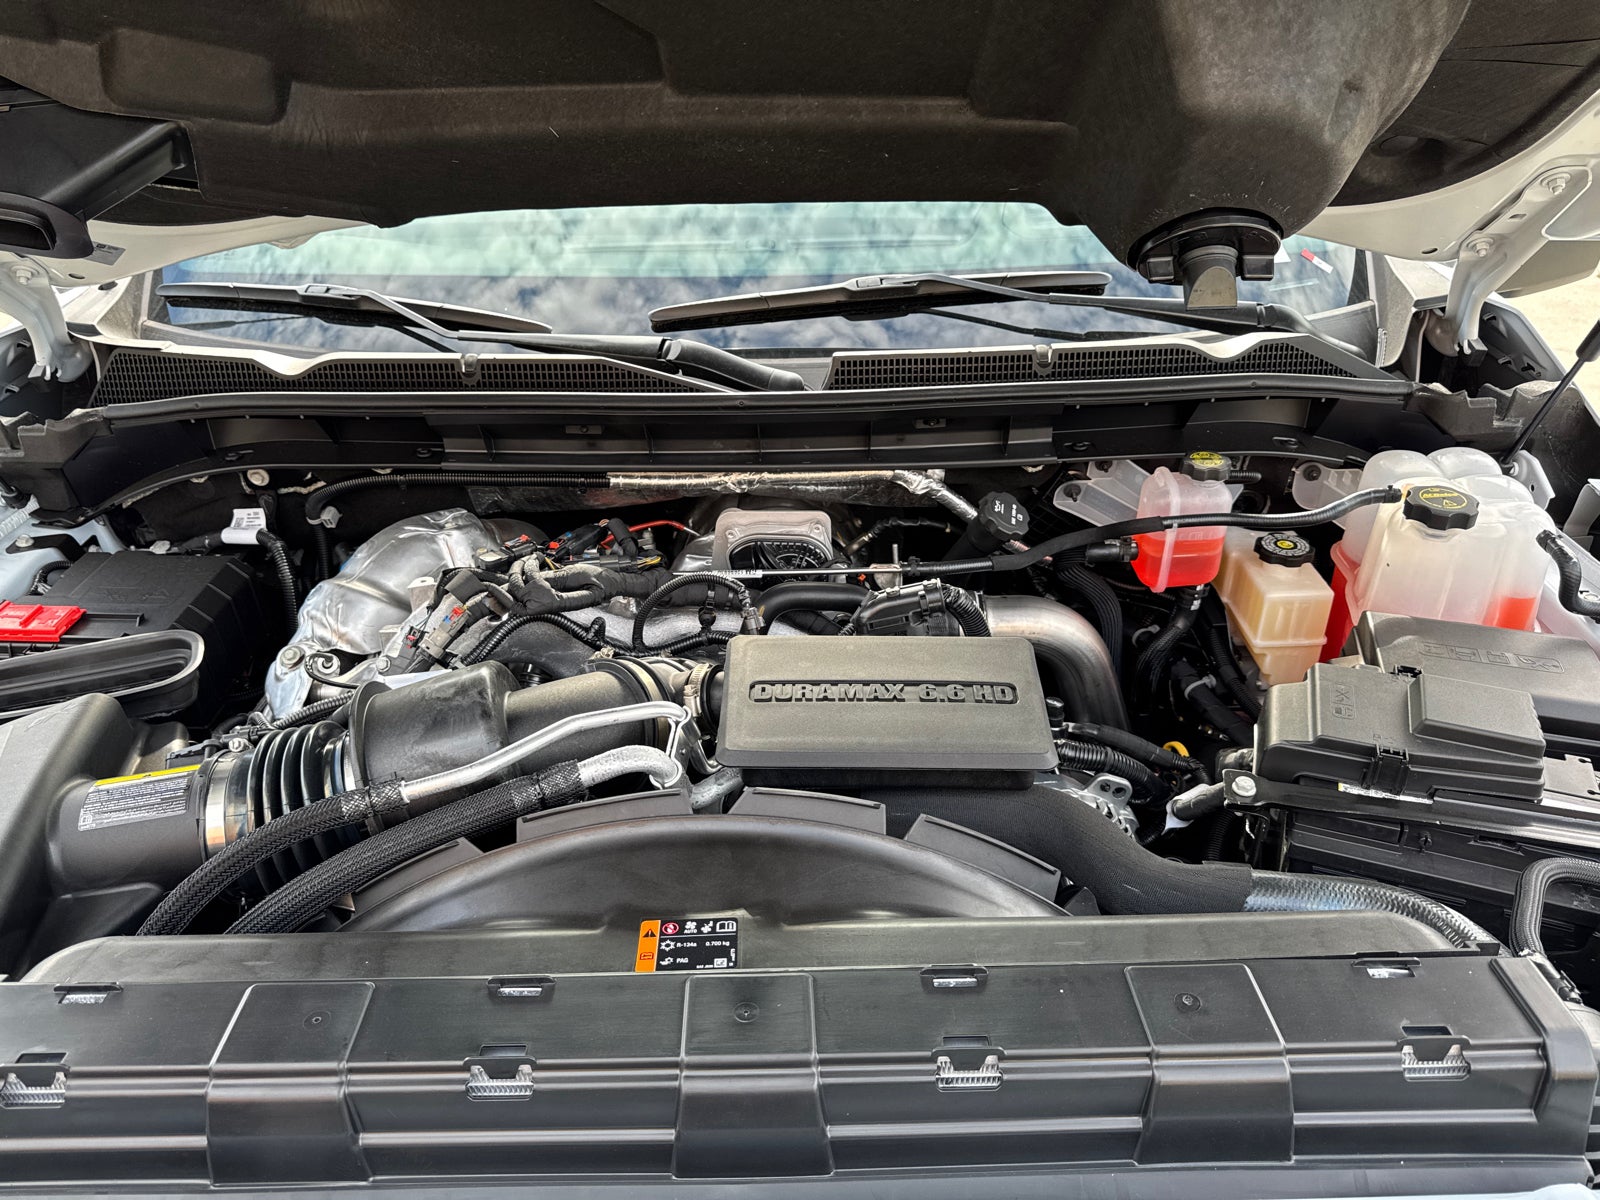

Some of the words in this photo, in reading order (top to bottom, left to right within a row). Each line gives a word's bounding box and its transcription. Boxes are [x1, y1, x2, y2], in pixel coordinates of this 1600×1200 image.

[752, 683, 906, 702] DURAMAX
[918, 683, 967, 702] 6.6
[972, 684, 1015, 704] HD
